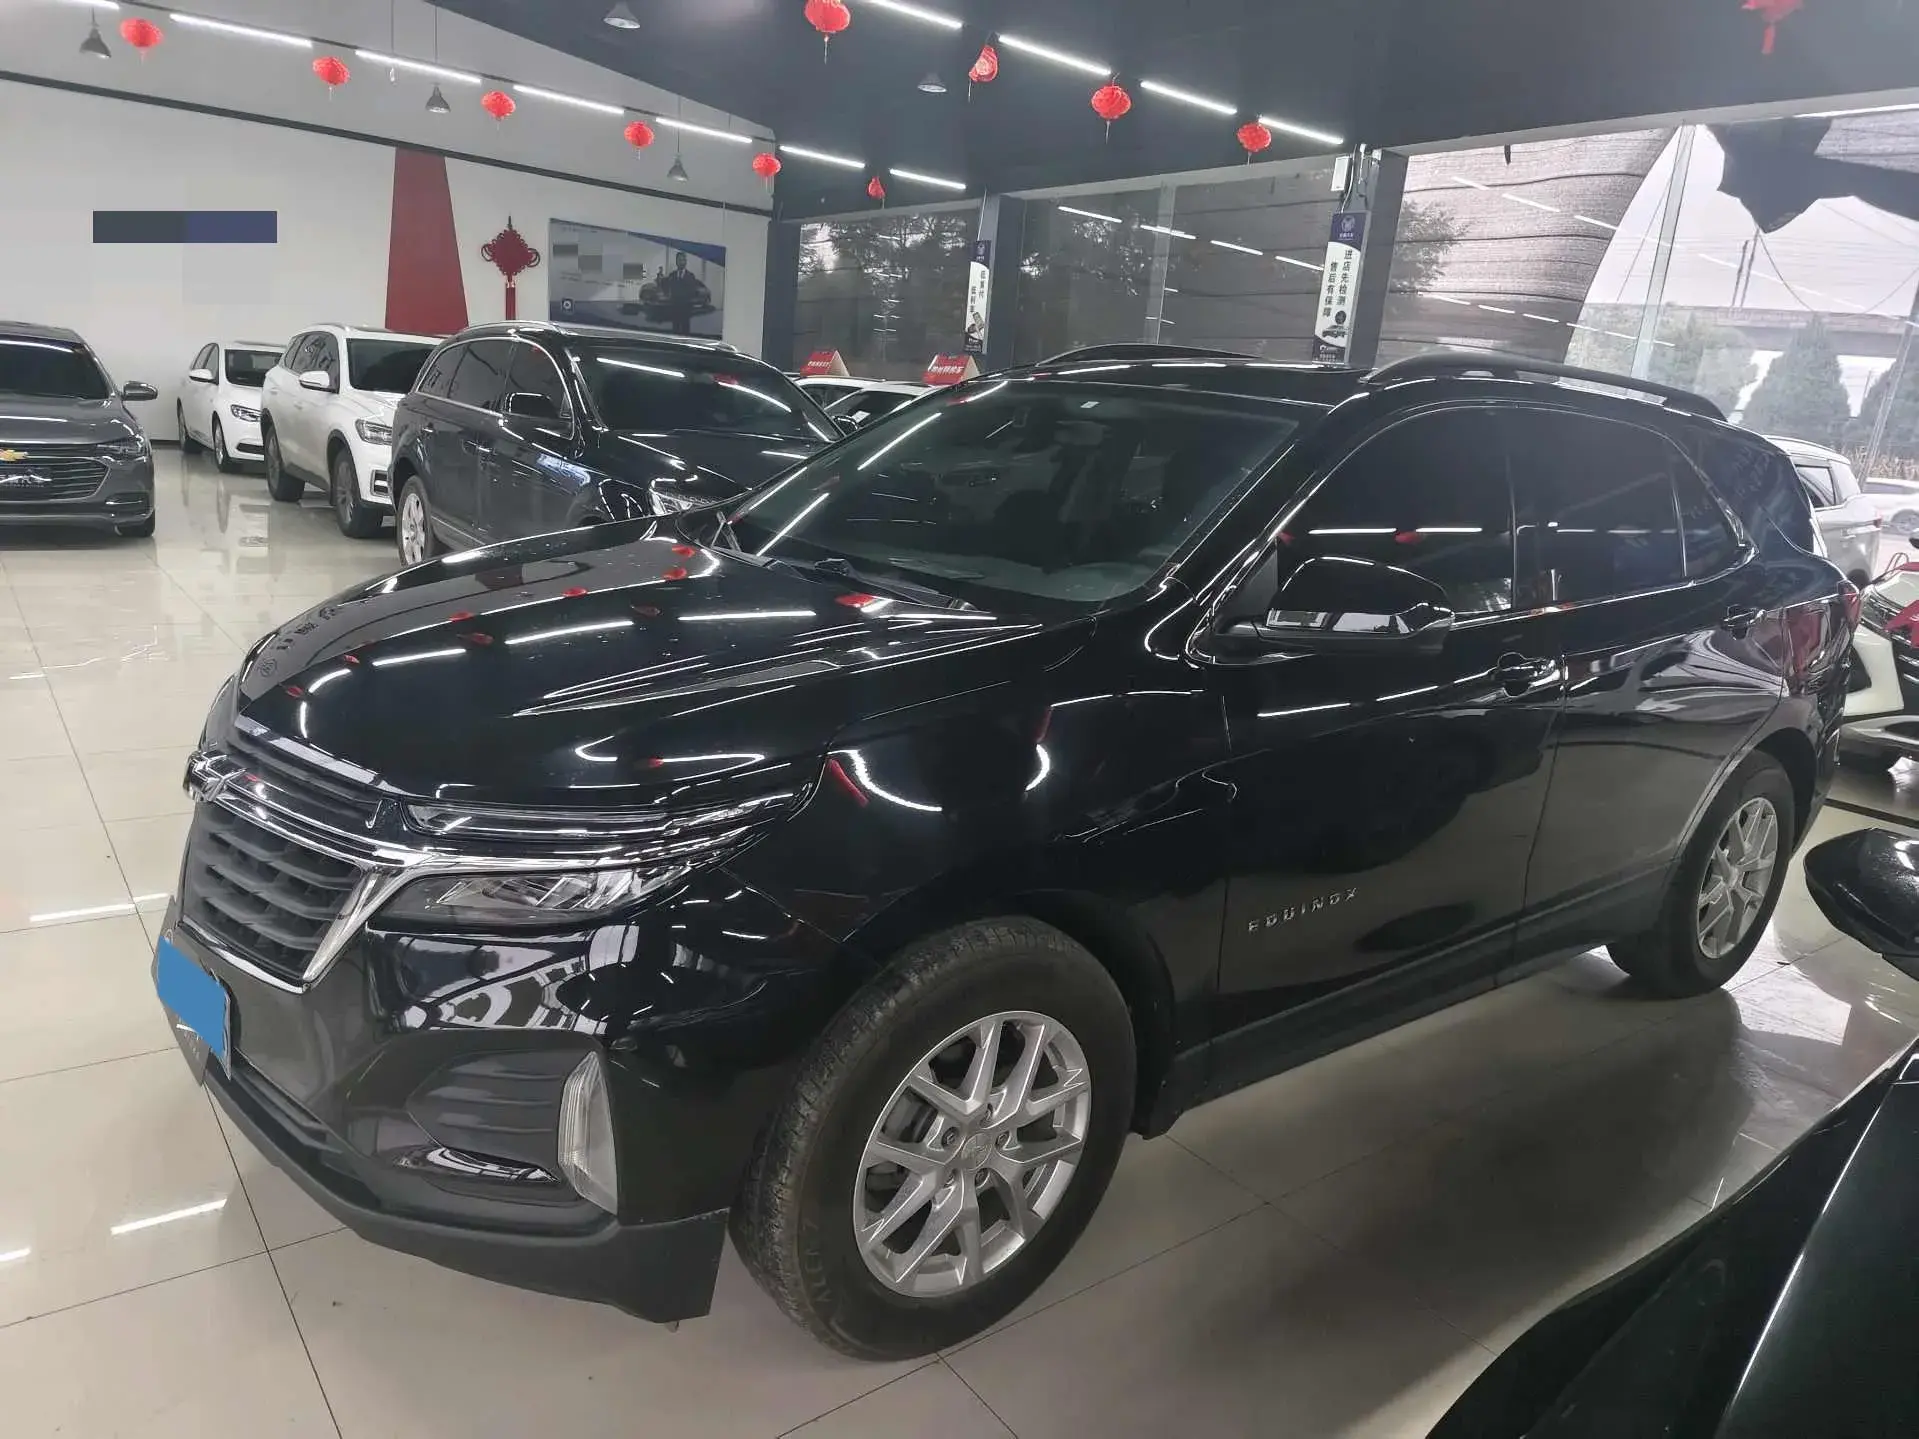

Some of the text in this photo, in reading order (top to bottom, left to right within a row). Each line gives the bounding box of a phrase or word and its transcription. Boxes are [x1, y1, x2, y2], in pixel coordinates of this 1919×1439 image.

[1322, 261, 1339, 318] 售后有保障
[1336, 249, 1353, 306] 进店先检测
[1248, 887, 1357, 931] EQUINOX
